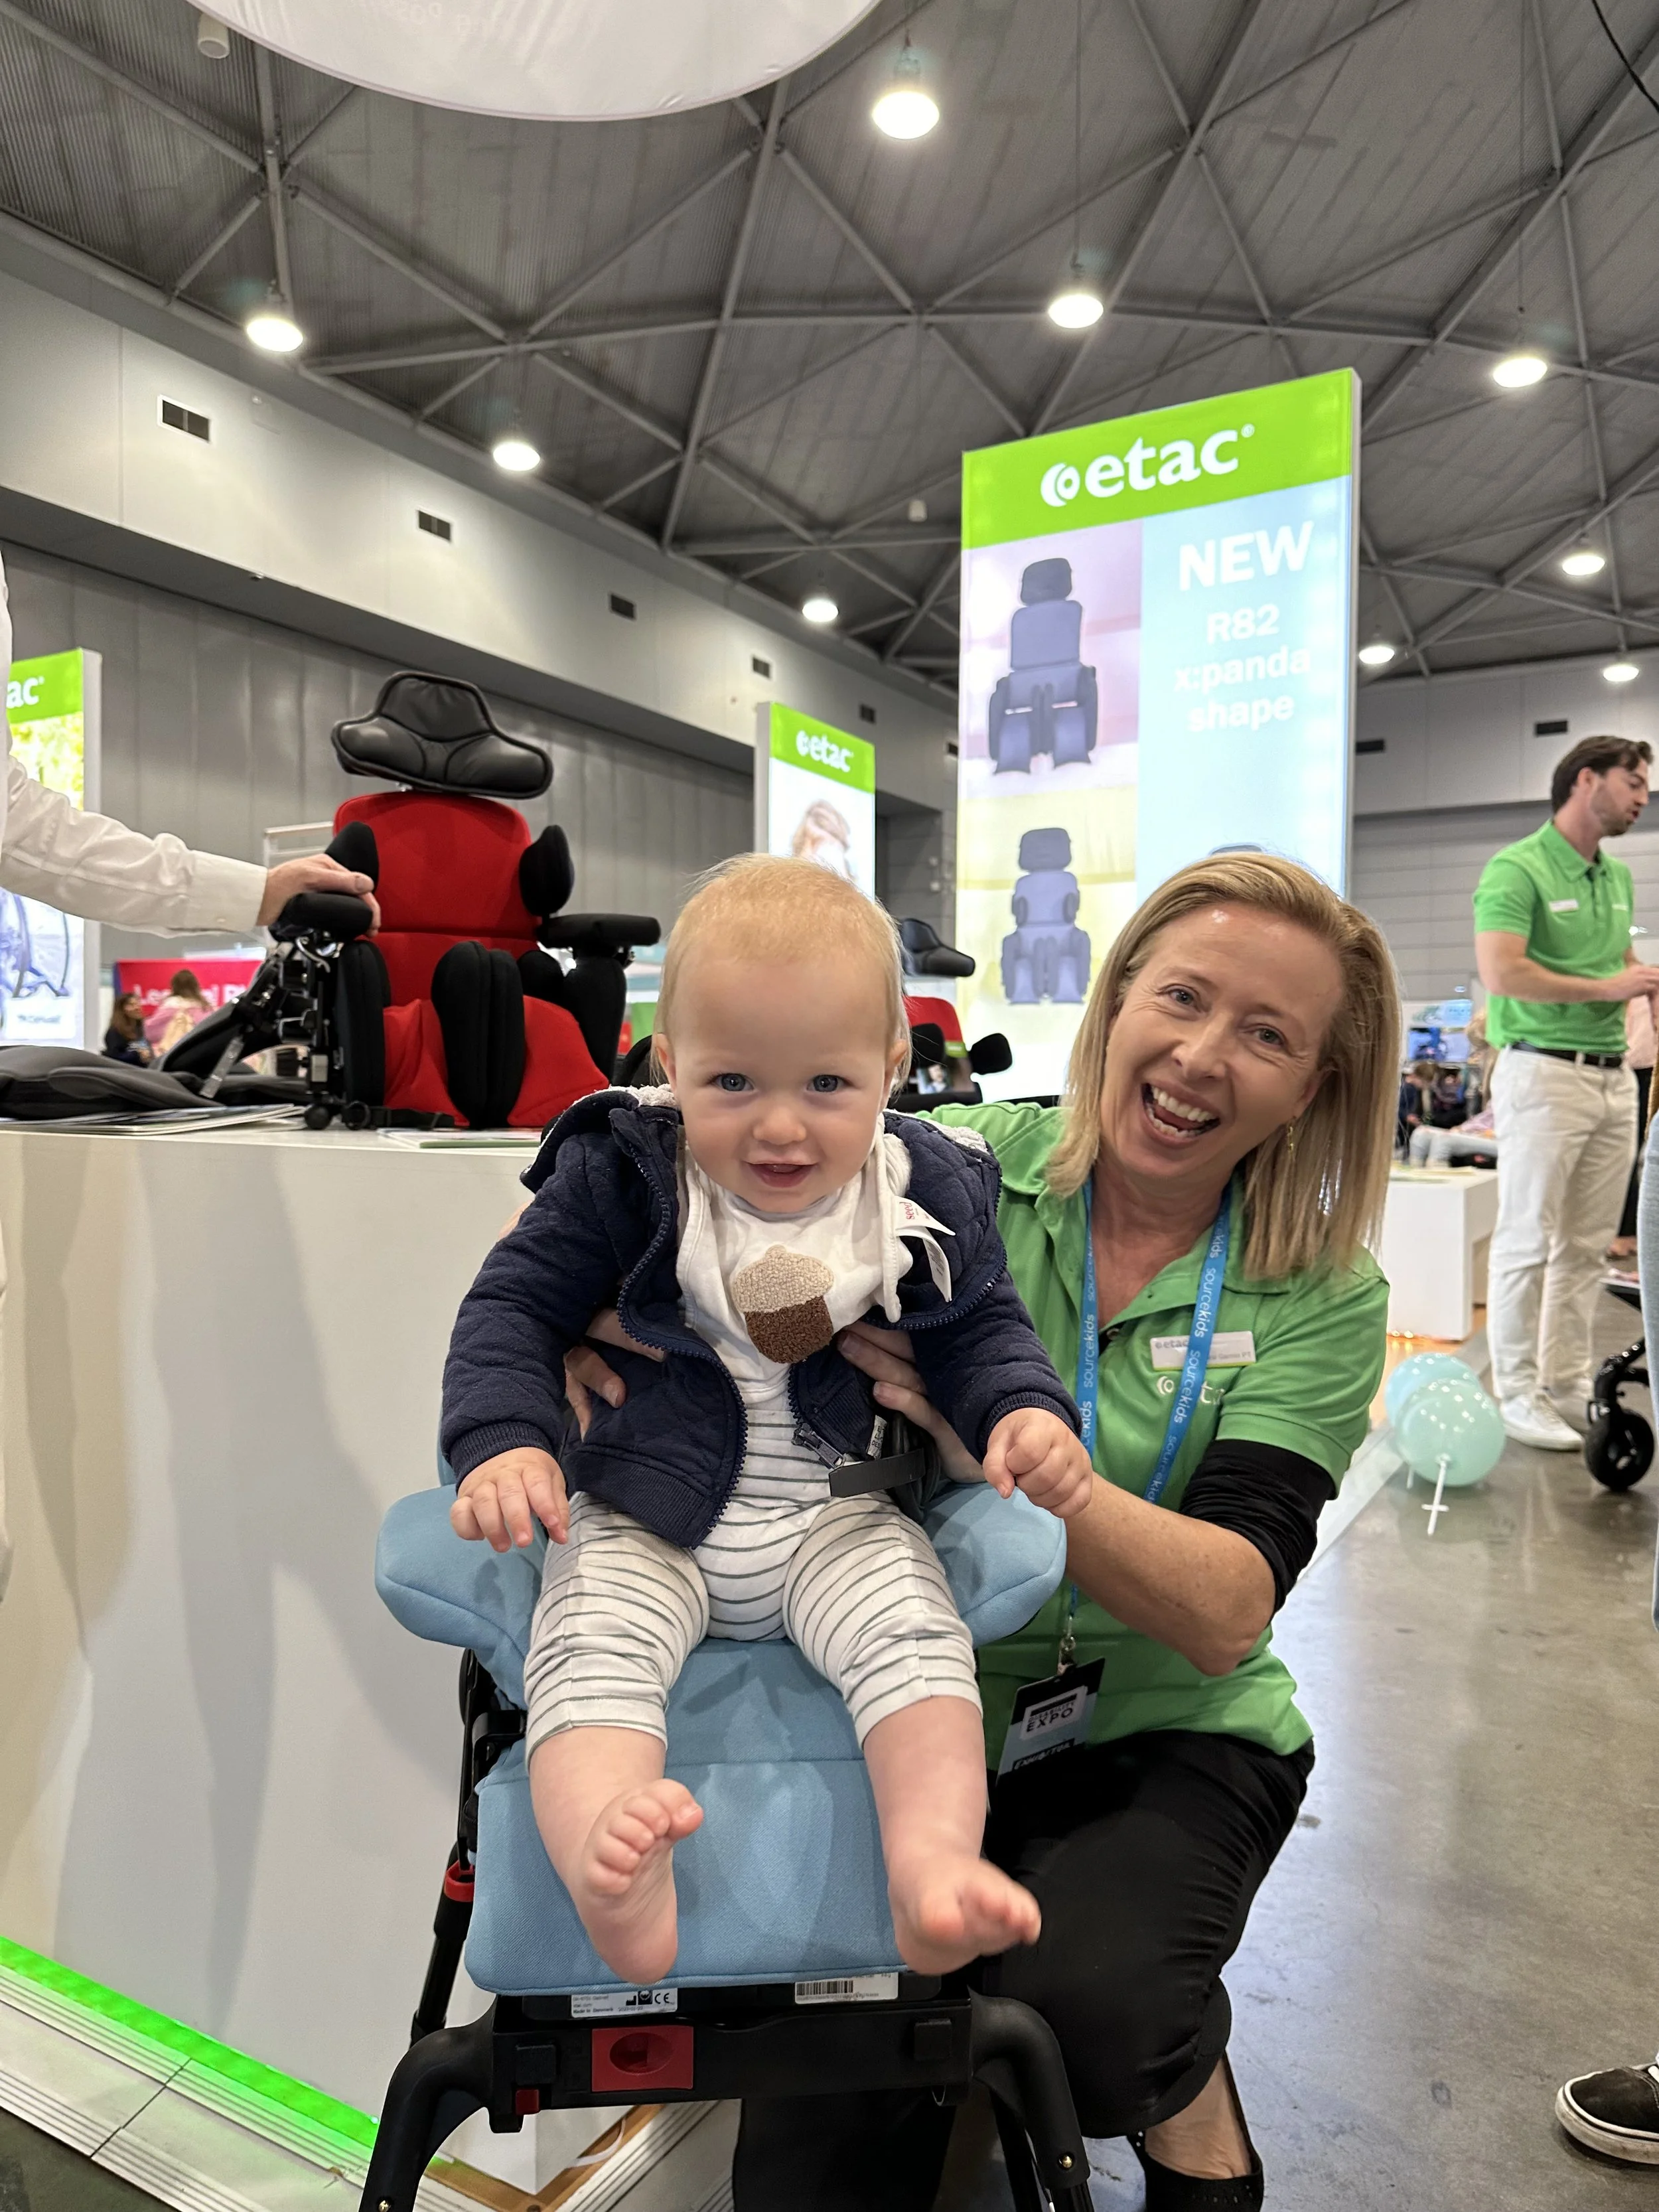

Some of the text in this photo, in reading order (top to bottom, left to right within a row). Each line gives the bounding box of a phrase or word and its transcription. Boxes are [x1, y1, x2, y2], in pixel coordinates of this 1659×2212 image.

[1179, 520, 1315, 591] NEW
[1206, 603, 1280, 645] R82
[7, 677, 40, 709] ac
[1173, 644, 1311, 696] x:panda
[1187, 694, 1295, 733] shape
[1194, 1268, 1216, 1338] sourcekids
[1083, 1313, 1095, 1388] sourcekids
[1173, 1349, 1201, 1424] sourcekids
[1080, 1400, 1092, 1446] cekids
[1147, 1435, 1177, 1502] sourcekid
[1026, 1708, 1073, 1733] EXPO
